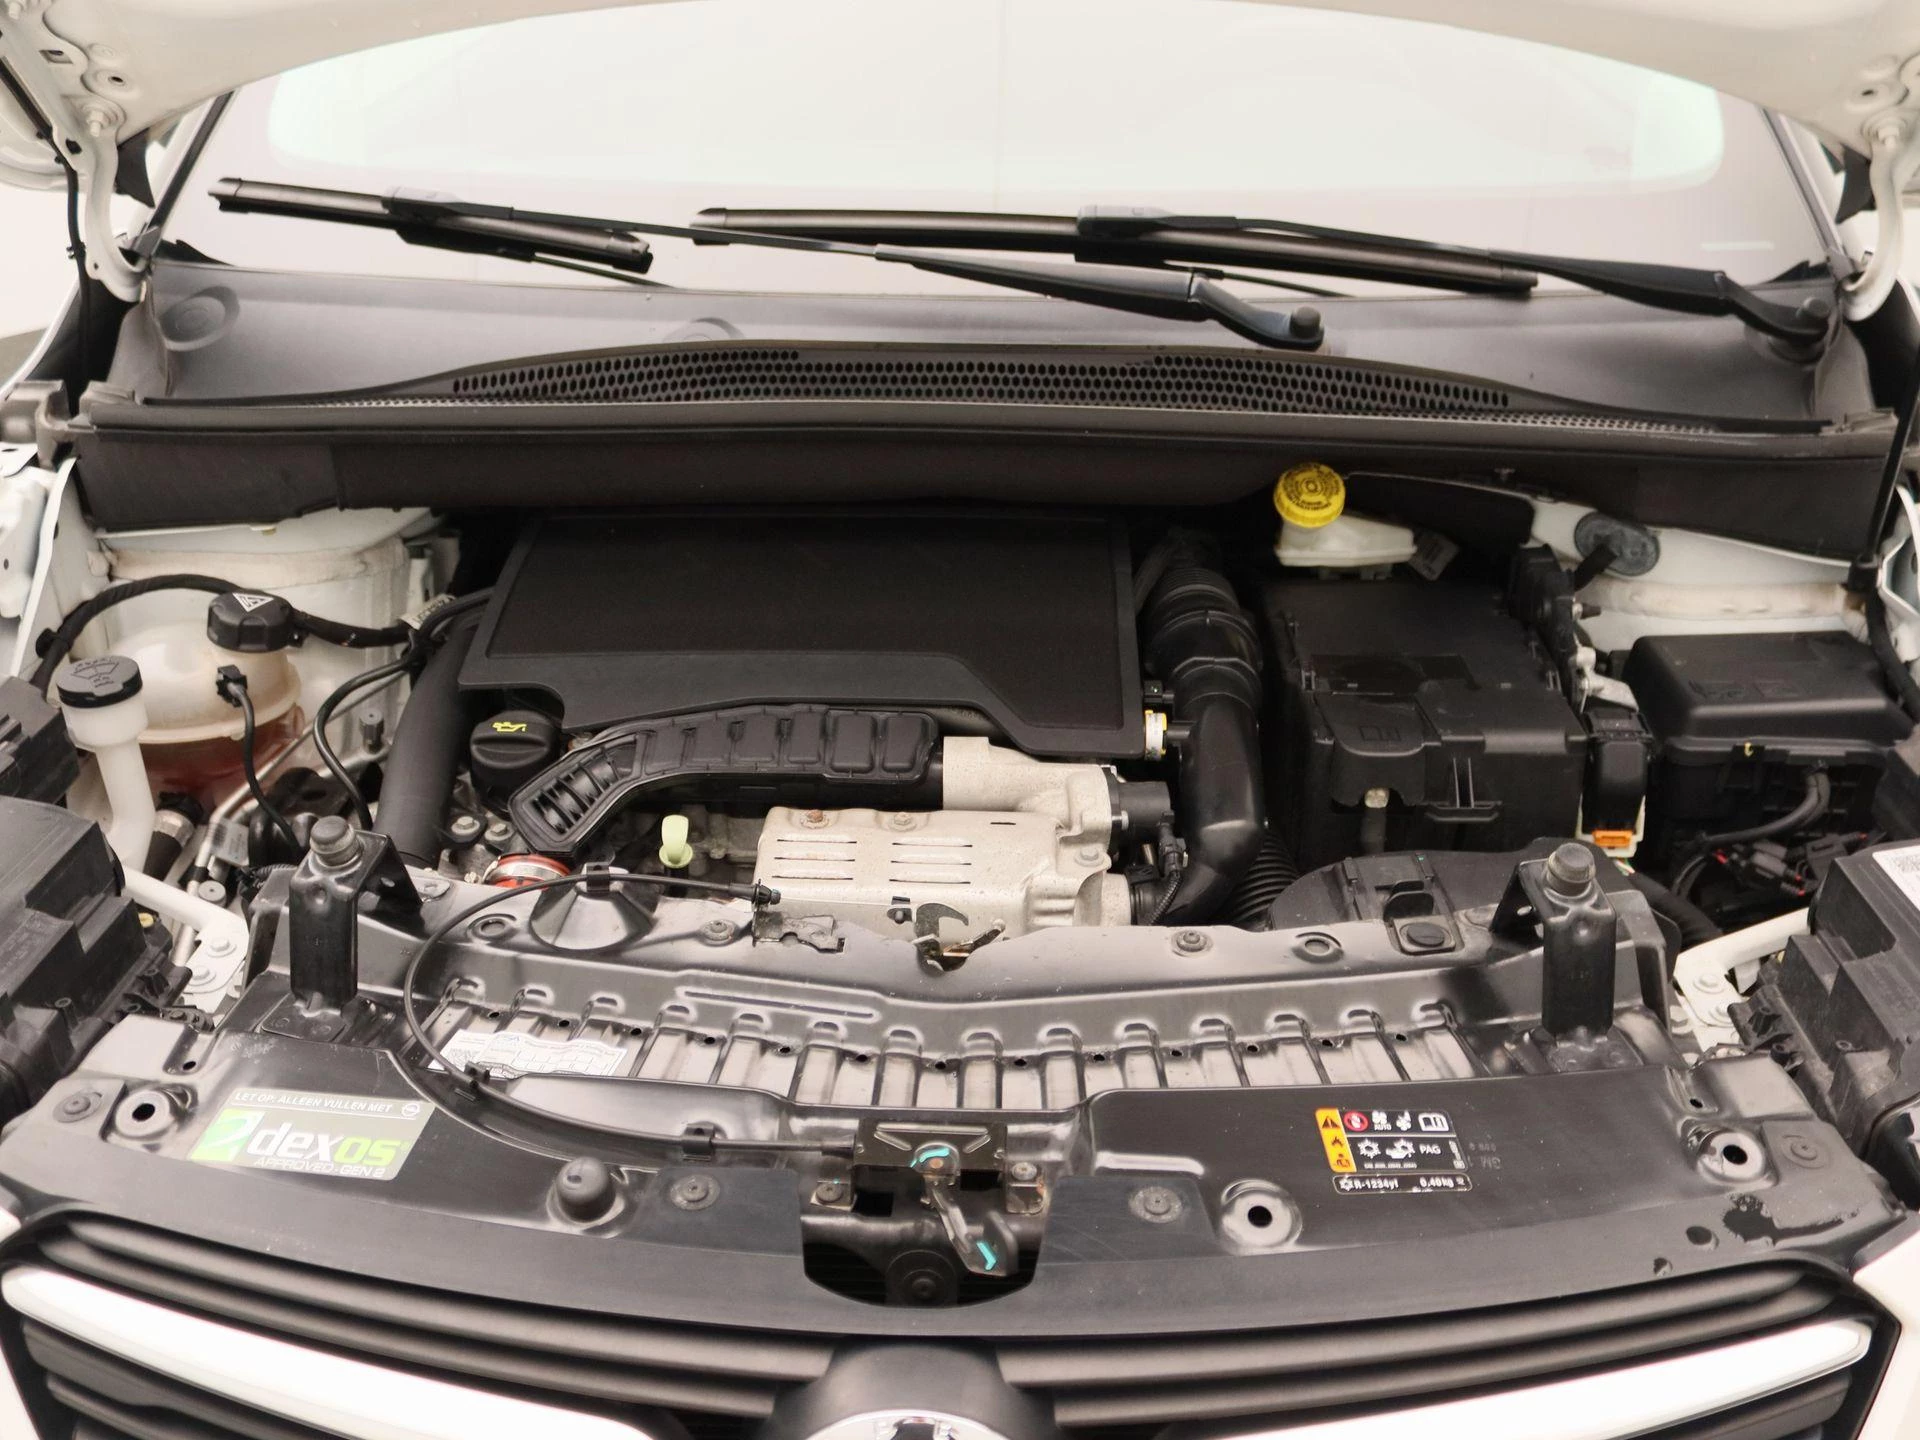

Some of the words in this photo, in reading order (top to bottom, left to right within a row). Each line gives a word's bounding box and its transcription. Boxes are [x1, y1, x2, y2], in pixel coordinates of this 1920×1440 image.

[235, 1092, 257, 1102] LET
[277, 1095, 322, 1107] ALLEEN
[324, 1098, 366, 1111] VULLEN
[367, 1102, 393, 1113] MET
[247, 1121, 400, 1167] dexos
[1419, 1144, 1442, 1155] PAG
